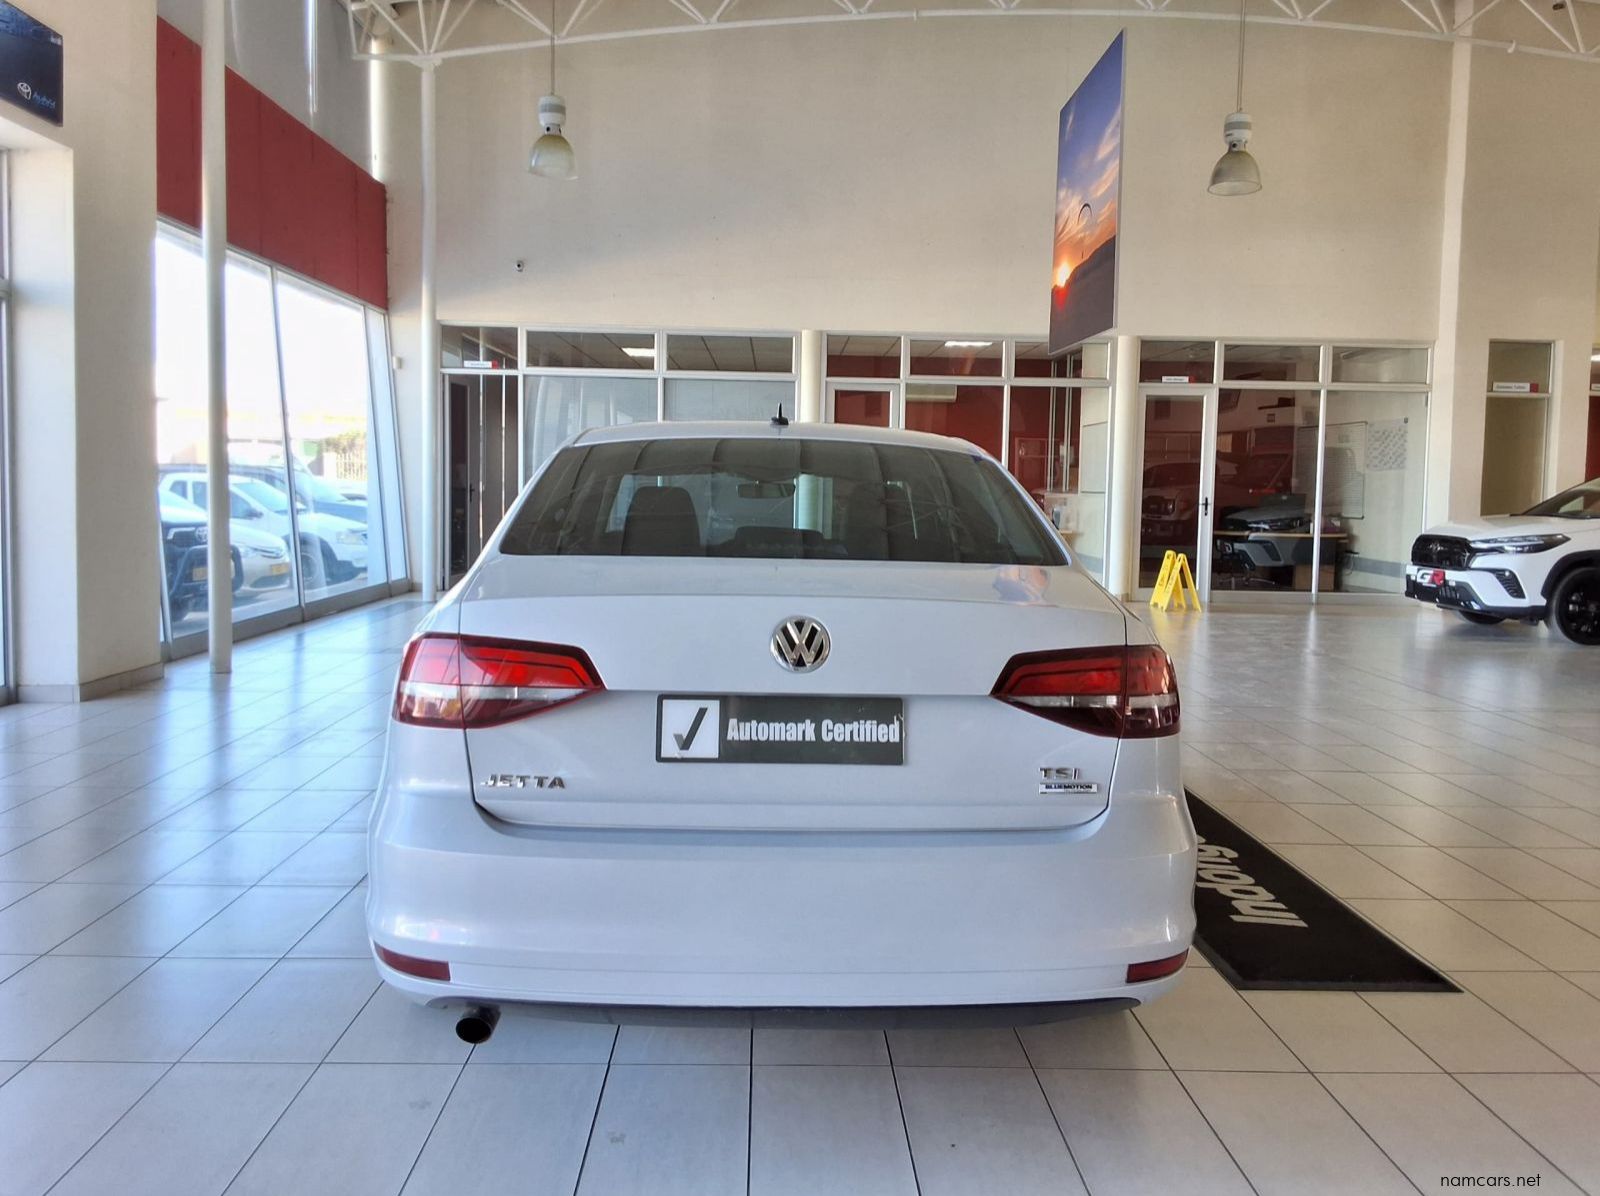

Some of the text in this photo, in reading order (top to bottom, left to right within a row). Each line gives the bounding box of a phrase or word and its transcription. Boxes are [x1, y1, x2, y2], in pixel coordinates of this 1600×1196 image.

[726, 715, 900, 743] Automark Certified
[480, 774, 565, 789] JETTA
[1039, 767, 1079, 781] TSI
